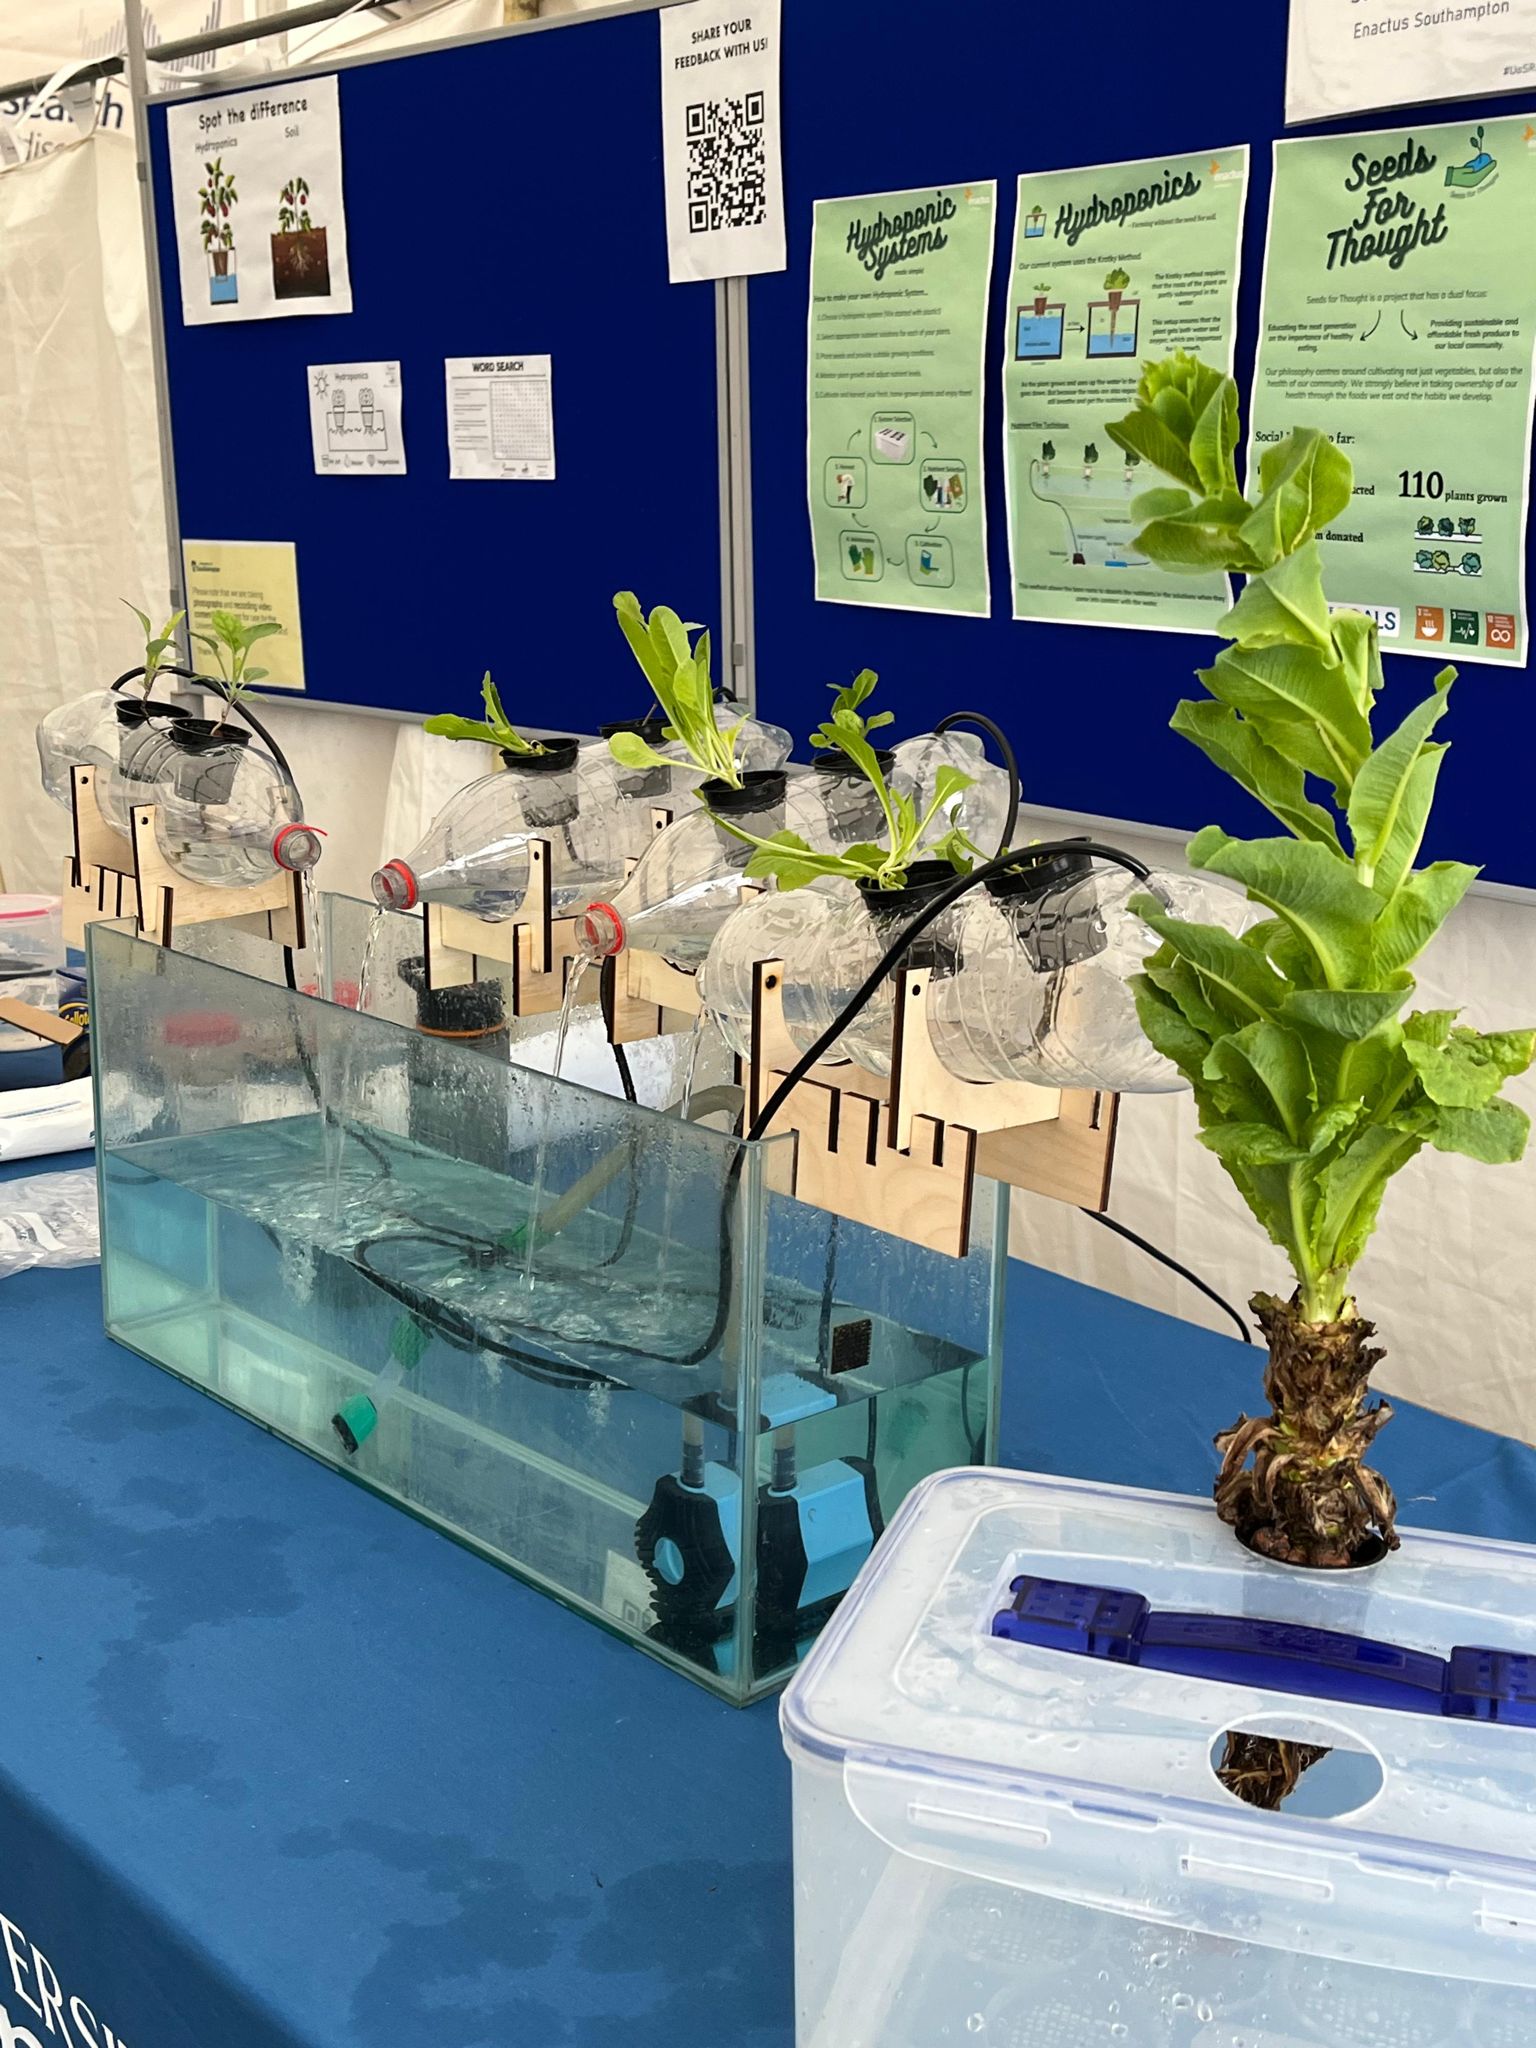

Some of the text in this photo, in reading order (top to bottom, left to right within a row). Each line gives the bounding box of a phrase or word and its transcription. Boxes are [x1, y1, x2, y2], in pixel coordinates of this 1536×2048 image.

[692, 18, 752, 44] SHARE YOUR
[1353, 1, 1509, 39] Enactus Southampton
[675, 37, 768, 69] FEEDBACK WITH US!
[199, 99, 307, 133] Spot the difference
[195, 125, 299, 154] Hydroponics Soil
[1345, 138, 1436, 191] Seeds
[1055, 170, 1201, 246] Hydroponics
[1353, 187, 1415, 230] For
[847, 191, 956, 261] Hydroponic
[1327, 204, 1448, 270] Thought
[864, 227, 947, 281] Systems
[1306, 295, 1327, 304] Seeds
[1328, 294, 1339, 303] for
[1339, 293, 1368, 304] Thought
[1369, 292, 1376, 302] is
[1376, 294, 1382, 302] a
[1382, 292, 1408, 302] project
[1409, 292, 1425, 300] that
[1426, 291, 1440, 299] has
[1440, 291, 1446, 299] a
[1447, 289, 1465, 299] dual
[1427, 329, 1519, 338] affordable fresh produce to
[1430, 317, 1519, 328] Providing sustainable and
[1447, 341, 1464, 349] local
[472, 361, 524, 372] WORD SEARCH
[1265, 367, 1277, 376] Our
[1277, 367, 1315, 377] philosophy
[1341, 367, 1367, 375] around
[1366, 366, 1404, 377] cultivating
[1405, 367, 1418, 375] not
[1418, 366, 1433, 377] just
[1478, 366, 1492, 375] but
[1492, 366, 1509, 375] also
[1510, 366, 1523, 375] the
[1267, 379, 1288, 387] health
[1289, 379, 1296, 387] of
[1350, 379, 1363, 388] We
[1364, 379, 1393, 389] strongly
[1393, 379, 1420, 388] believe
[1421, 379, 1428, 387] in
[1429, 379, 1453, 390] taking
[1454, 380, 1494, 389] ownership
[1495, 378, 1504, 388] of
[1504, 380, 1518, 388] our
[1285, 391, 1306, 399] health
[1307, 391, 1334, 401] through
[1335, 391, 1347, 399] the
[1348, 390, 1368, 400] foods
[1381, 392, 1394, 400] eat
[1394, 391, 1409, 400] and
[1410, 391, 1423, 400] the
[1424, 391, 1447, 400] habits
[1255, 431, 1283, 442] Social
[1337, 432, 1355, 444] far:
[1398, 470, 1444, 499] 110
[1445, 490, 1474, 502] plants
[1477, 494, 1507, 505] grown
[1326, 530, 1363, 543] donated
